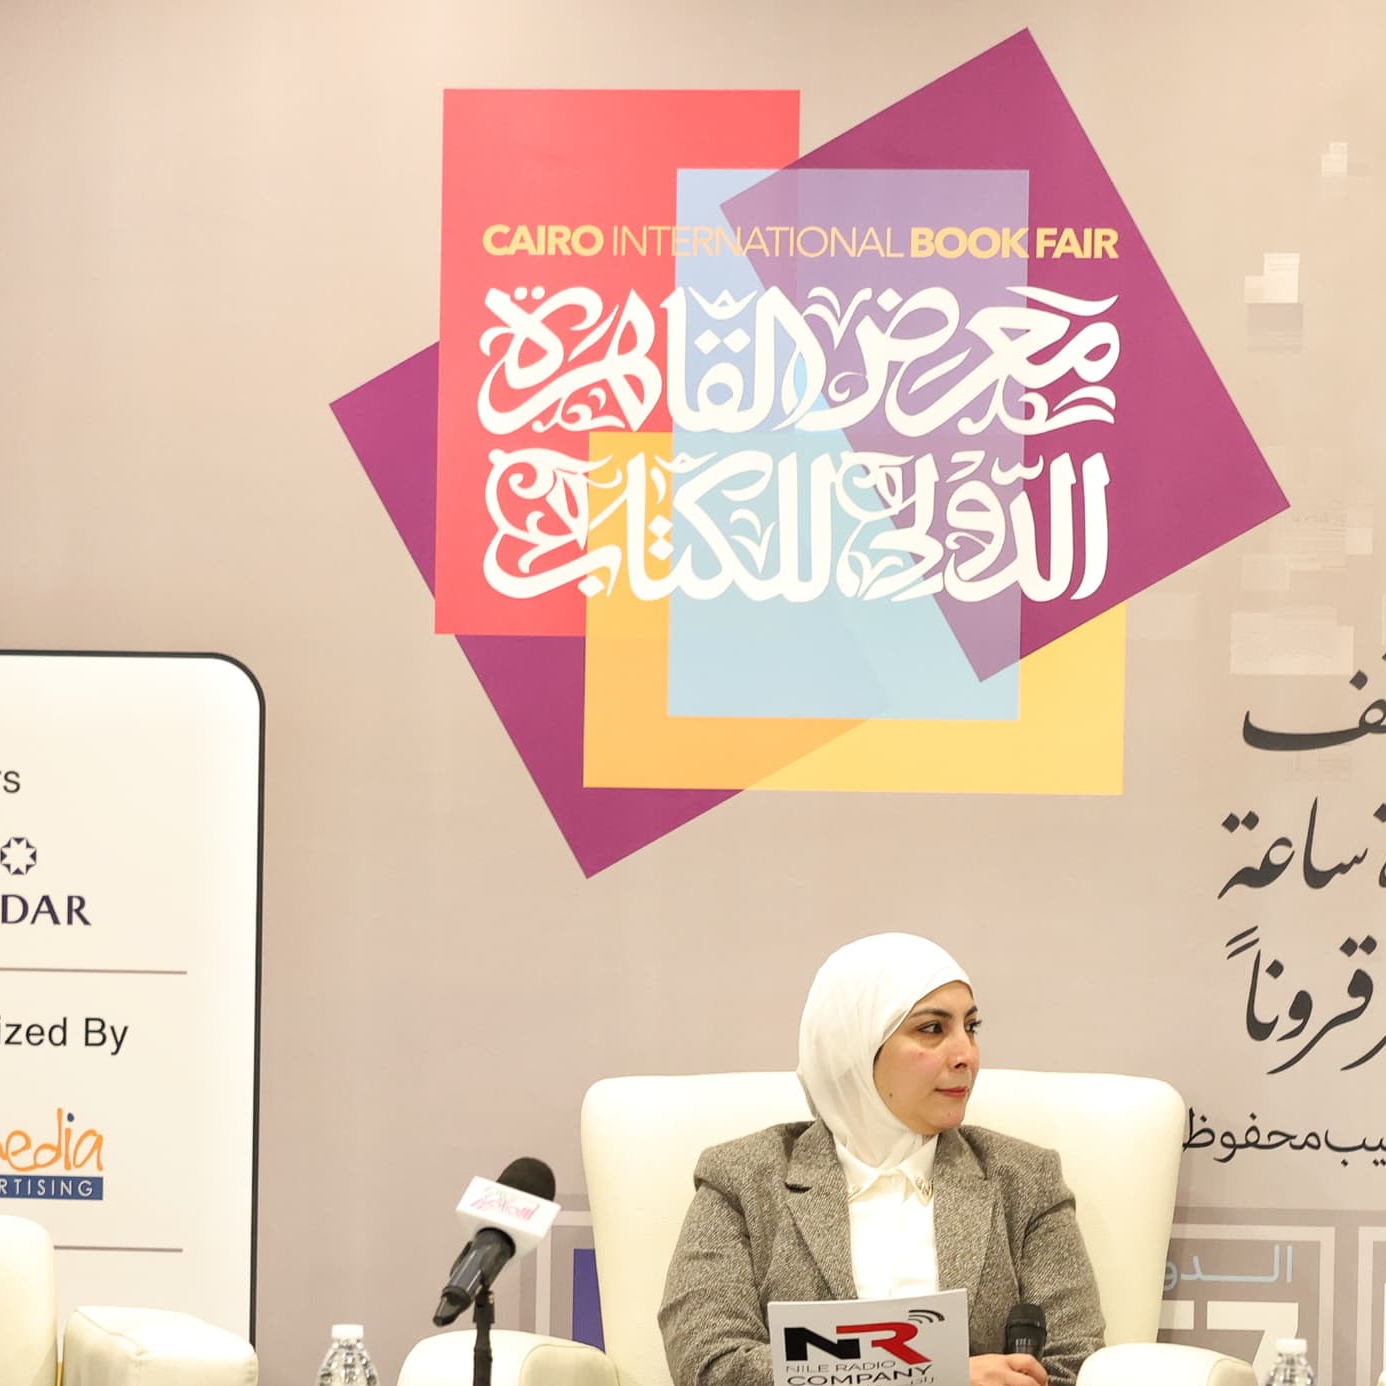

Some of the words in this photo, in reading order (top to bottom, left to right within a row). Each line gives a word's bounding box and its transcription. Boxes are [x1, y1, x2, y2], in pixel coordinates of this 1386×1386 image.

[482, 224, 604, 257] CAIRO
[612, 225, 904, 258] INTERNATIONAL
[910, 227, 1030, 259] BOOK
[1035, 227, 1119, 260] FAIR
[477, 286, 827, 436] القاهرة
[783, 286, 1121, 436] معرض
[482, 448, 841, 602] للكتاب
[1217, 796, 1369, 900] ساعة
[84, 1017, 129, 1055] By
[1182, 1107, 1321, 1163] محفوظ
[786, 1364, 830, 1374] NILE
[835, 1360, 897, 1372] RADIO
[787, 1364, 934, 1386] COMPANY
